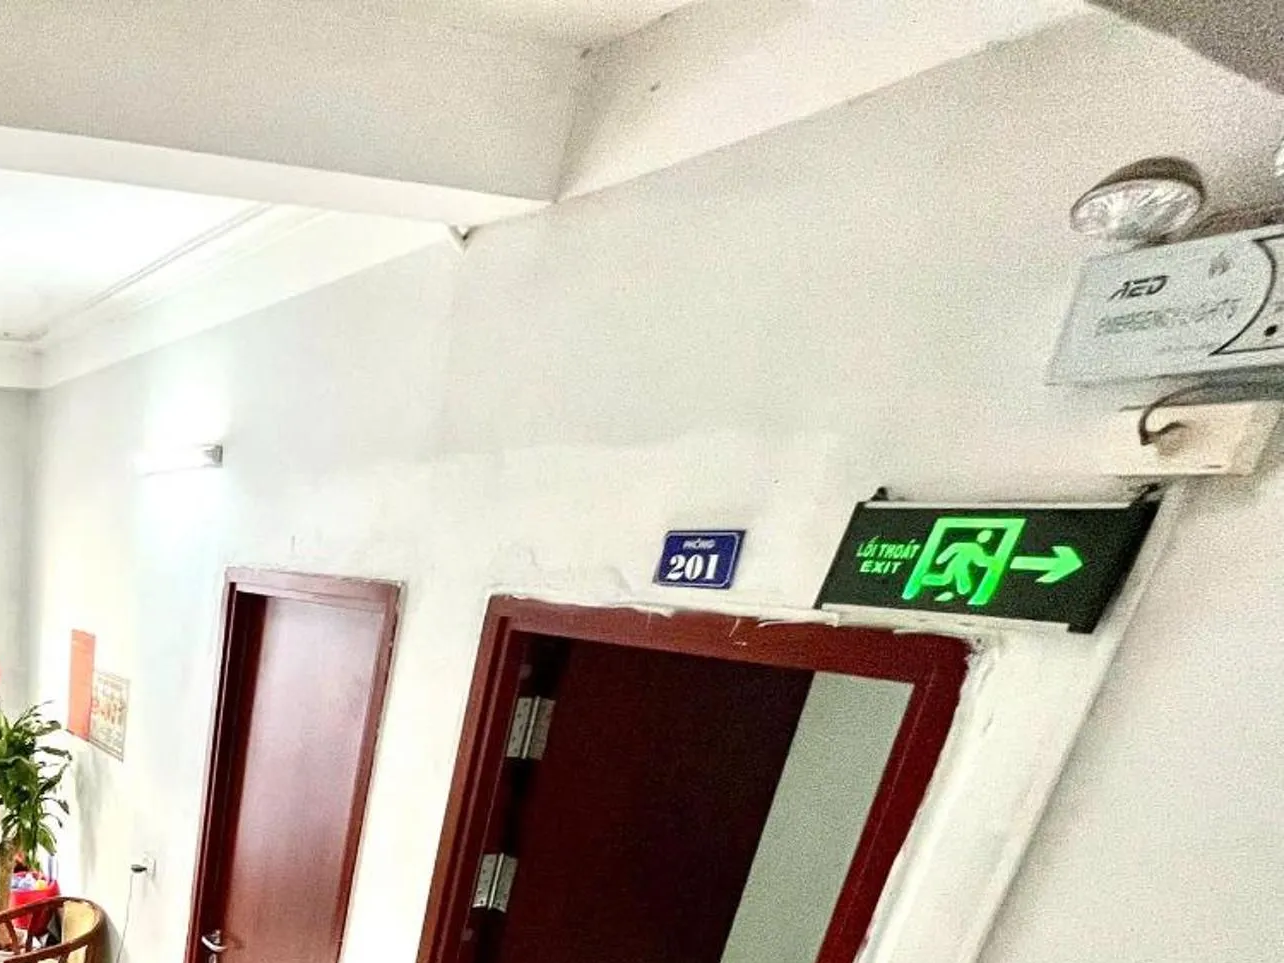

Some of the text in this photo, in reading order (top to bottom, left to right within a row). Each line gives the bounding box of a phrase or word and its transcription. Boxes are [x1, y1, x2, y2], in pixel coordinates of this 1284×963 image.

[878, 539, 921, 559] THOÁT
[666, 554, 719, 580] 201
[859, 560, 904, 574] EXIT
